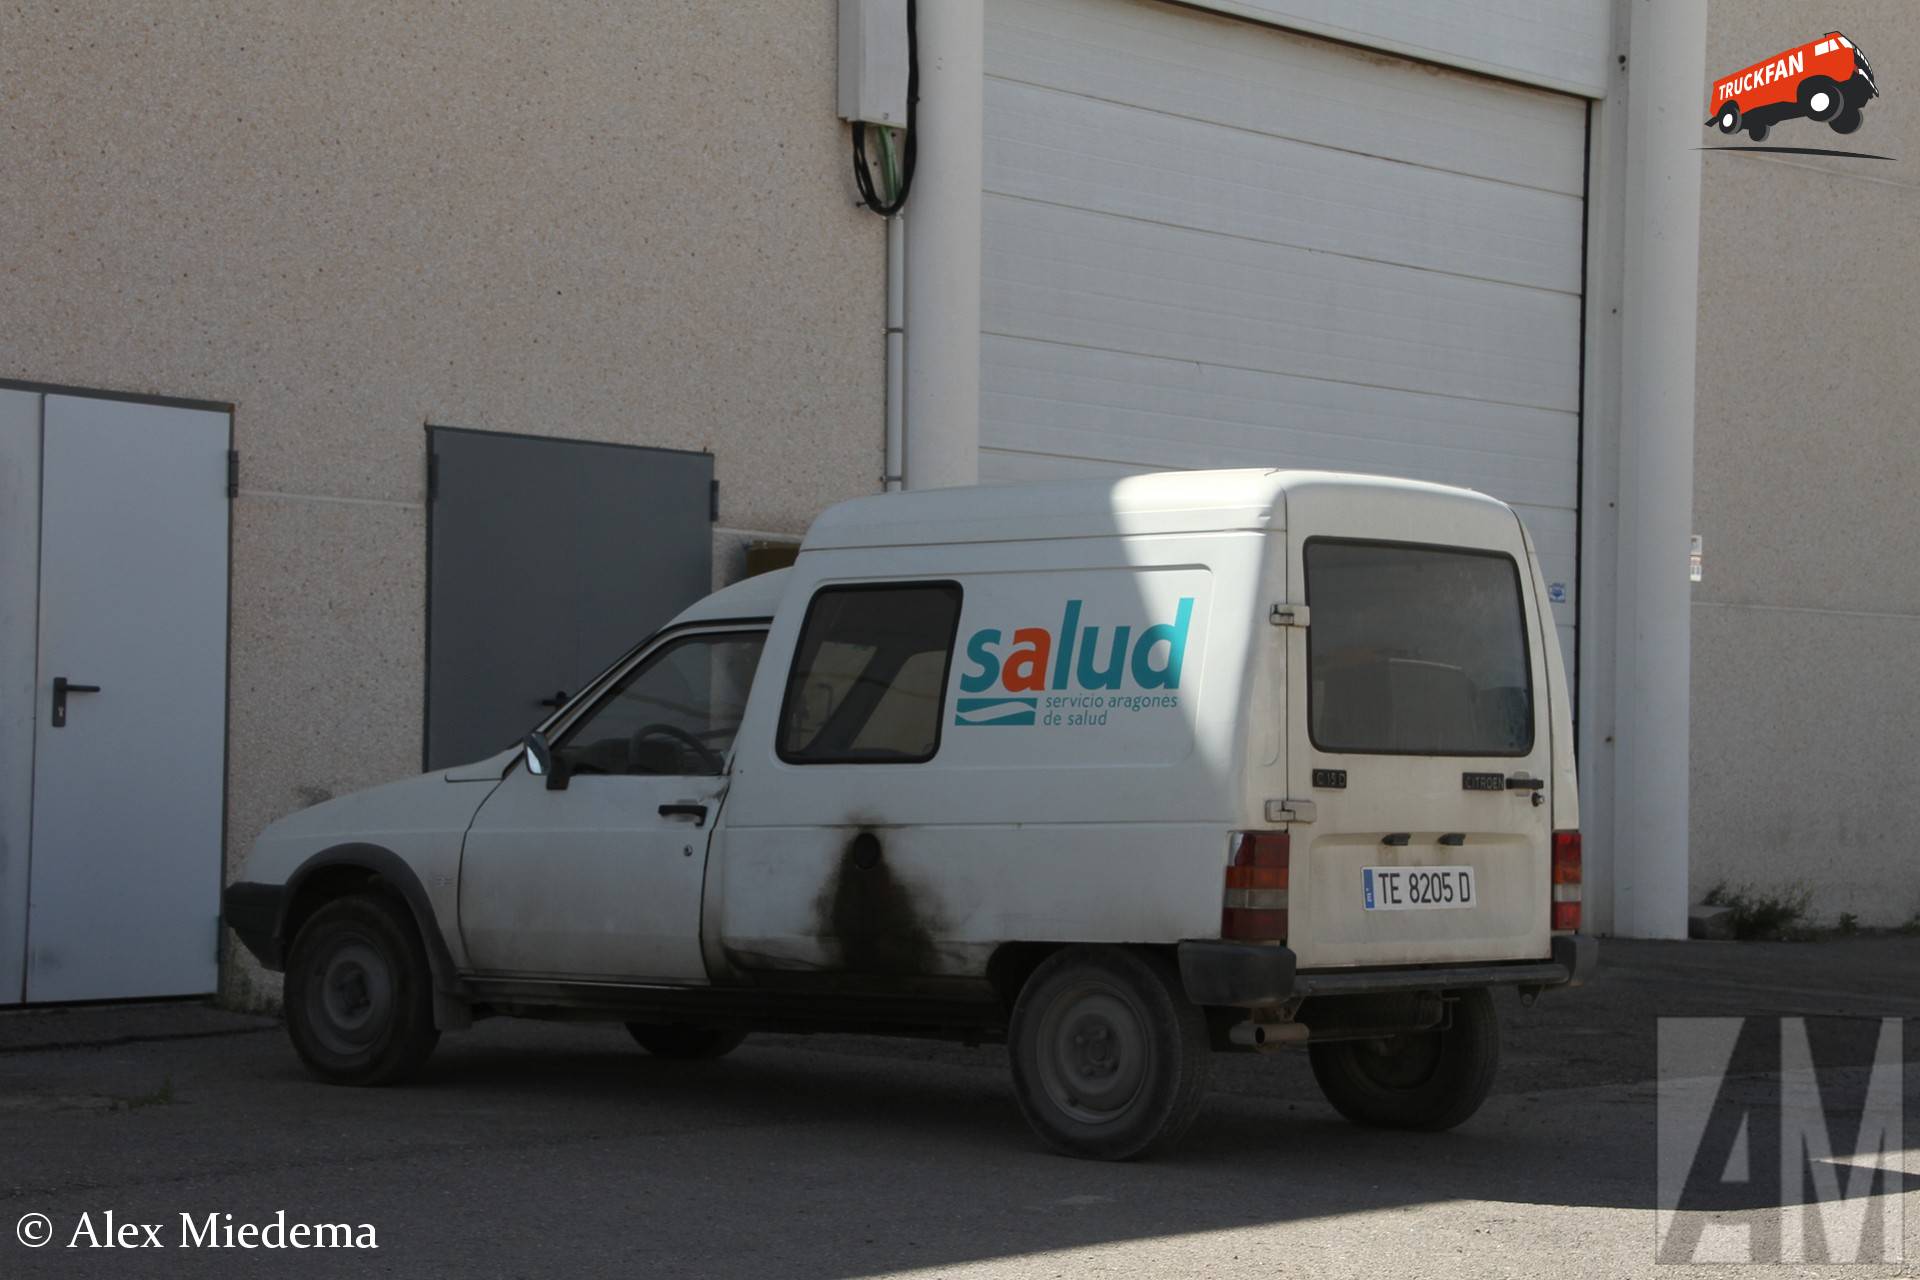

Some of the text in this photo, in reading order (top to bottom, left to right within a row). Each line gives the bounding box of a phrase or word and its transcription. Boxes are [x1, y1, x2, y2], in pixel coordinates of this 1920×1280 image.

[959, 597, 1195, 693] salud
[1045, 692, 1104, 708] servicio
[1043, 709, 1108, 726] de salud
[1378, 872, 1402, 904] TE
[1408, 872, 1454, 904] 8205
[1458, 872, 1471, 903] D
